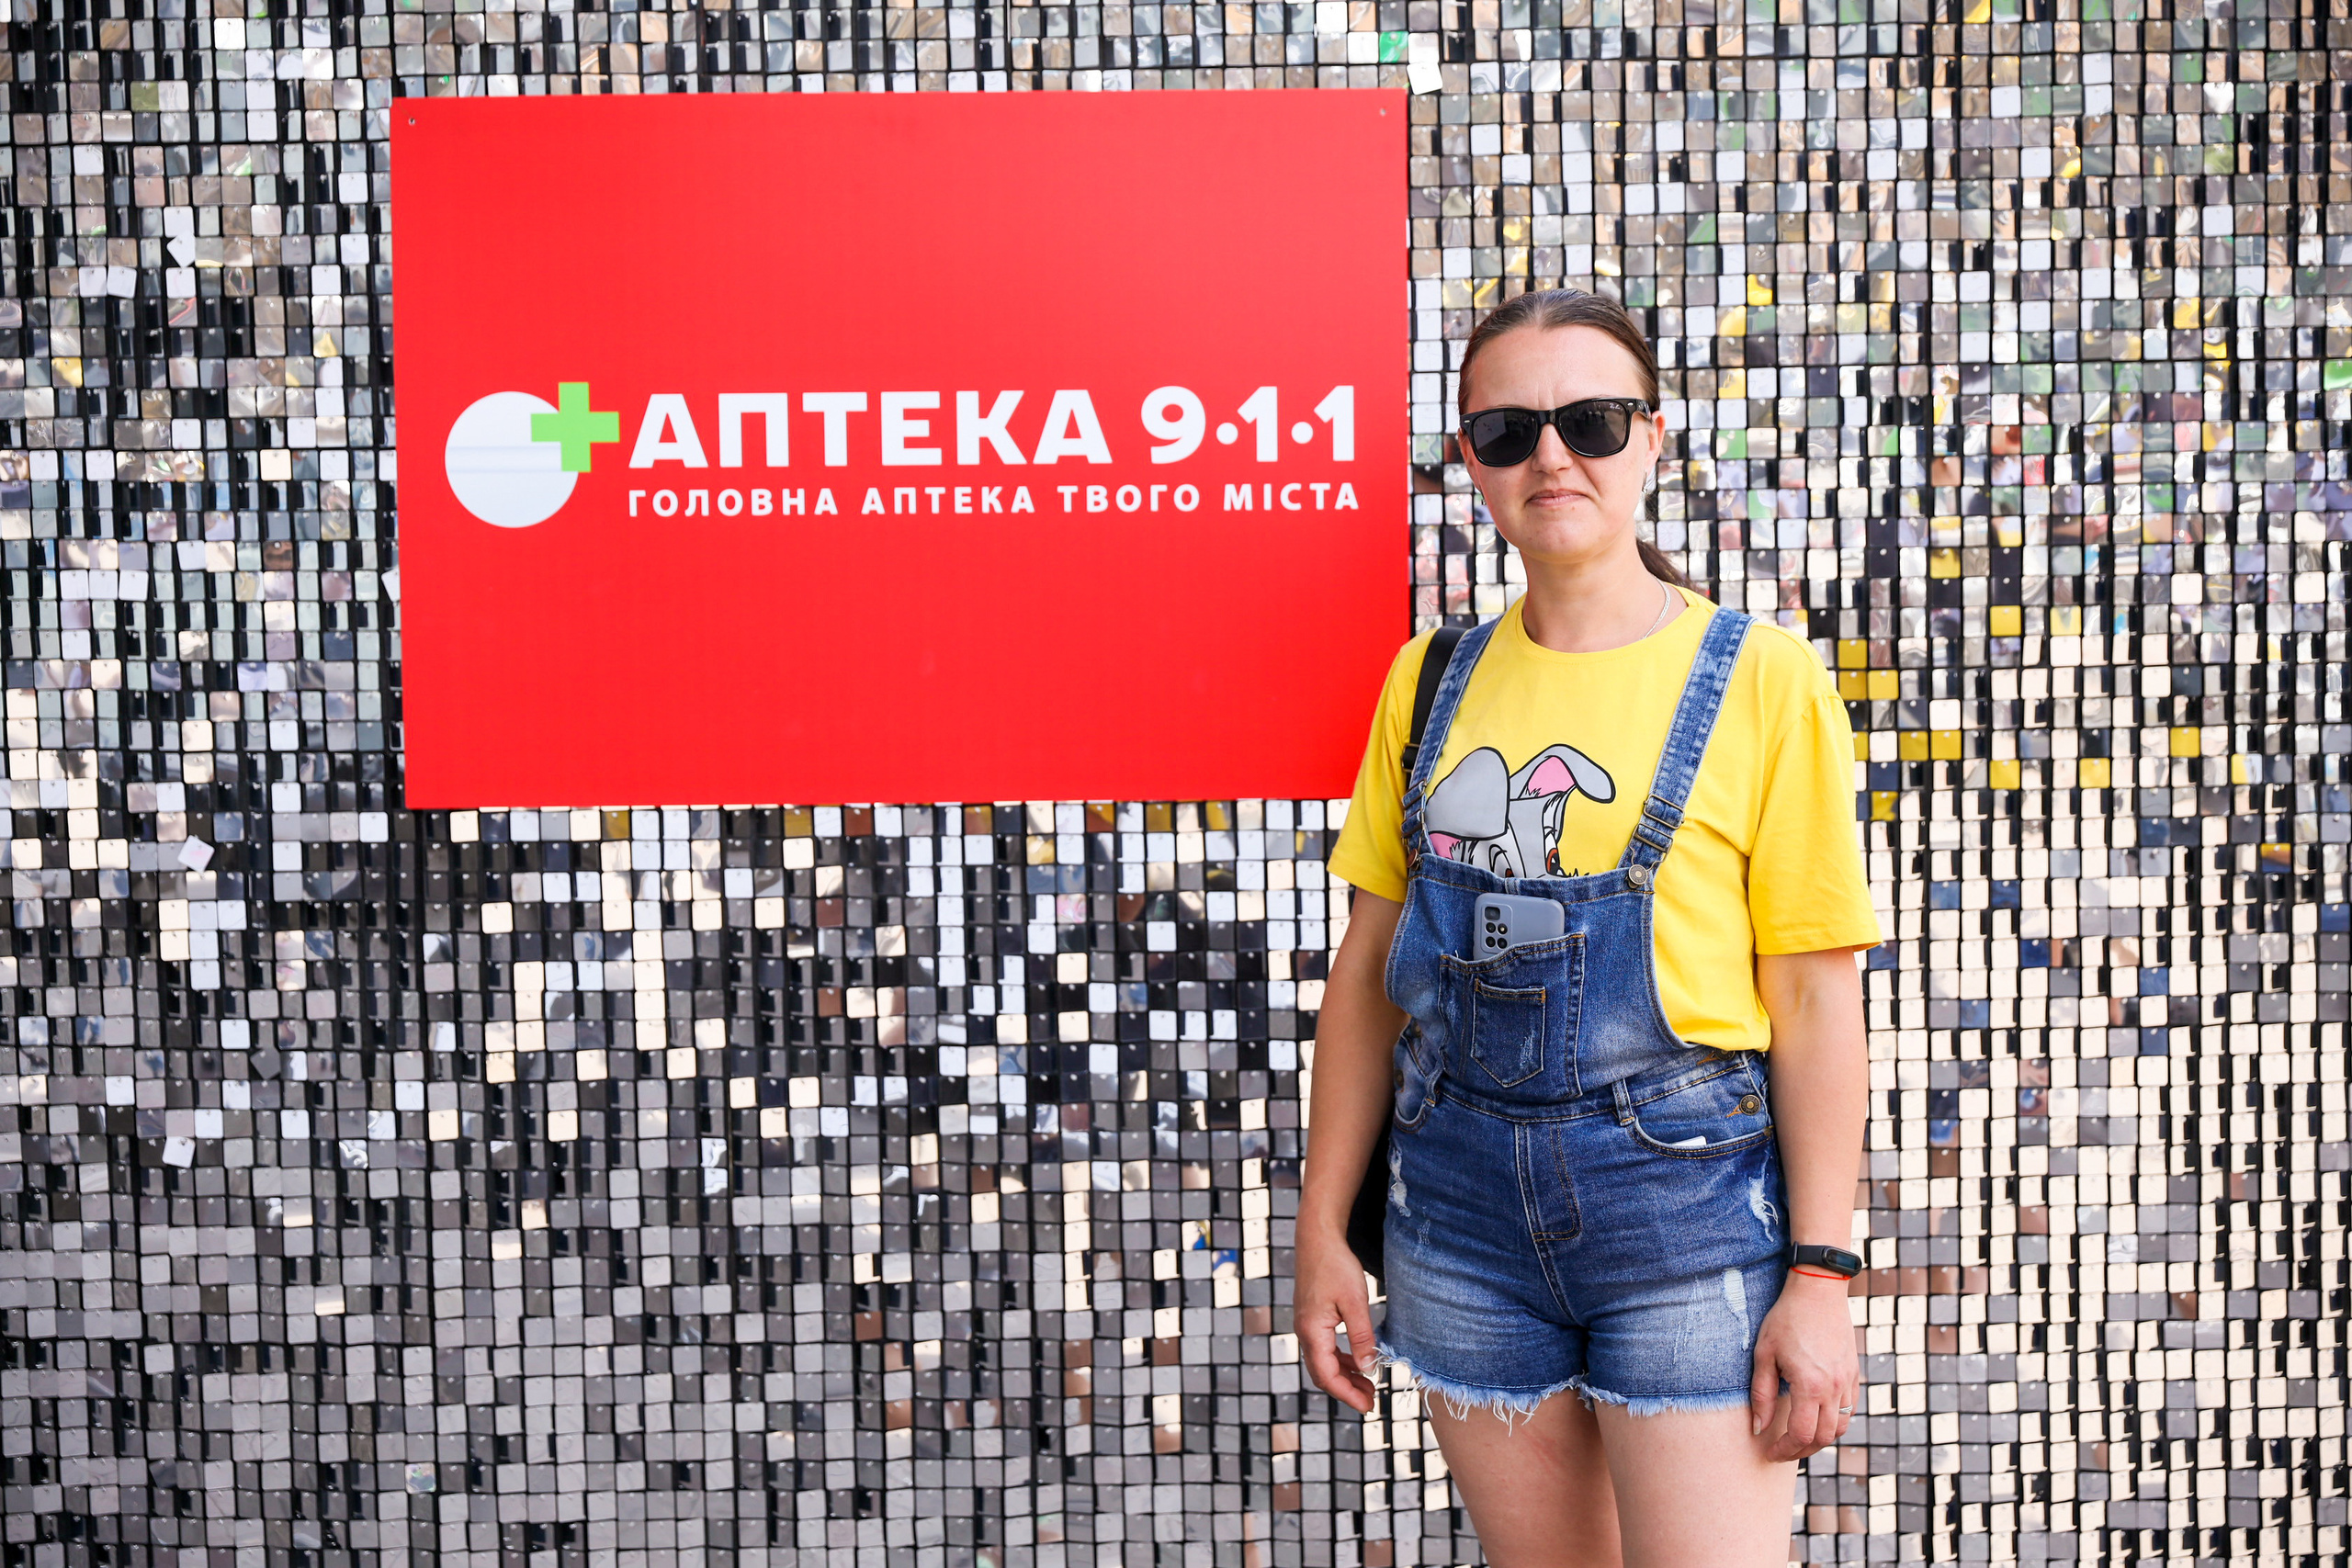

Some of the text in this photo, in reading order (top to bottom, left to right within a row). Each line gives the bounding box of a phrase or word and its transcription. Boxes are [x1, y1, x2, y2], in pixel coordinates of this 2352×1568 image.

[628, 389, 1114, 469] АПТЕКА
[628, 482, 1359, 517] ГОЛОВНА АПТЕКА ТВОГО МІСТА
